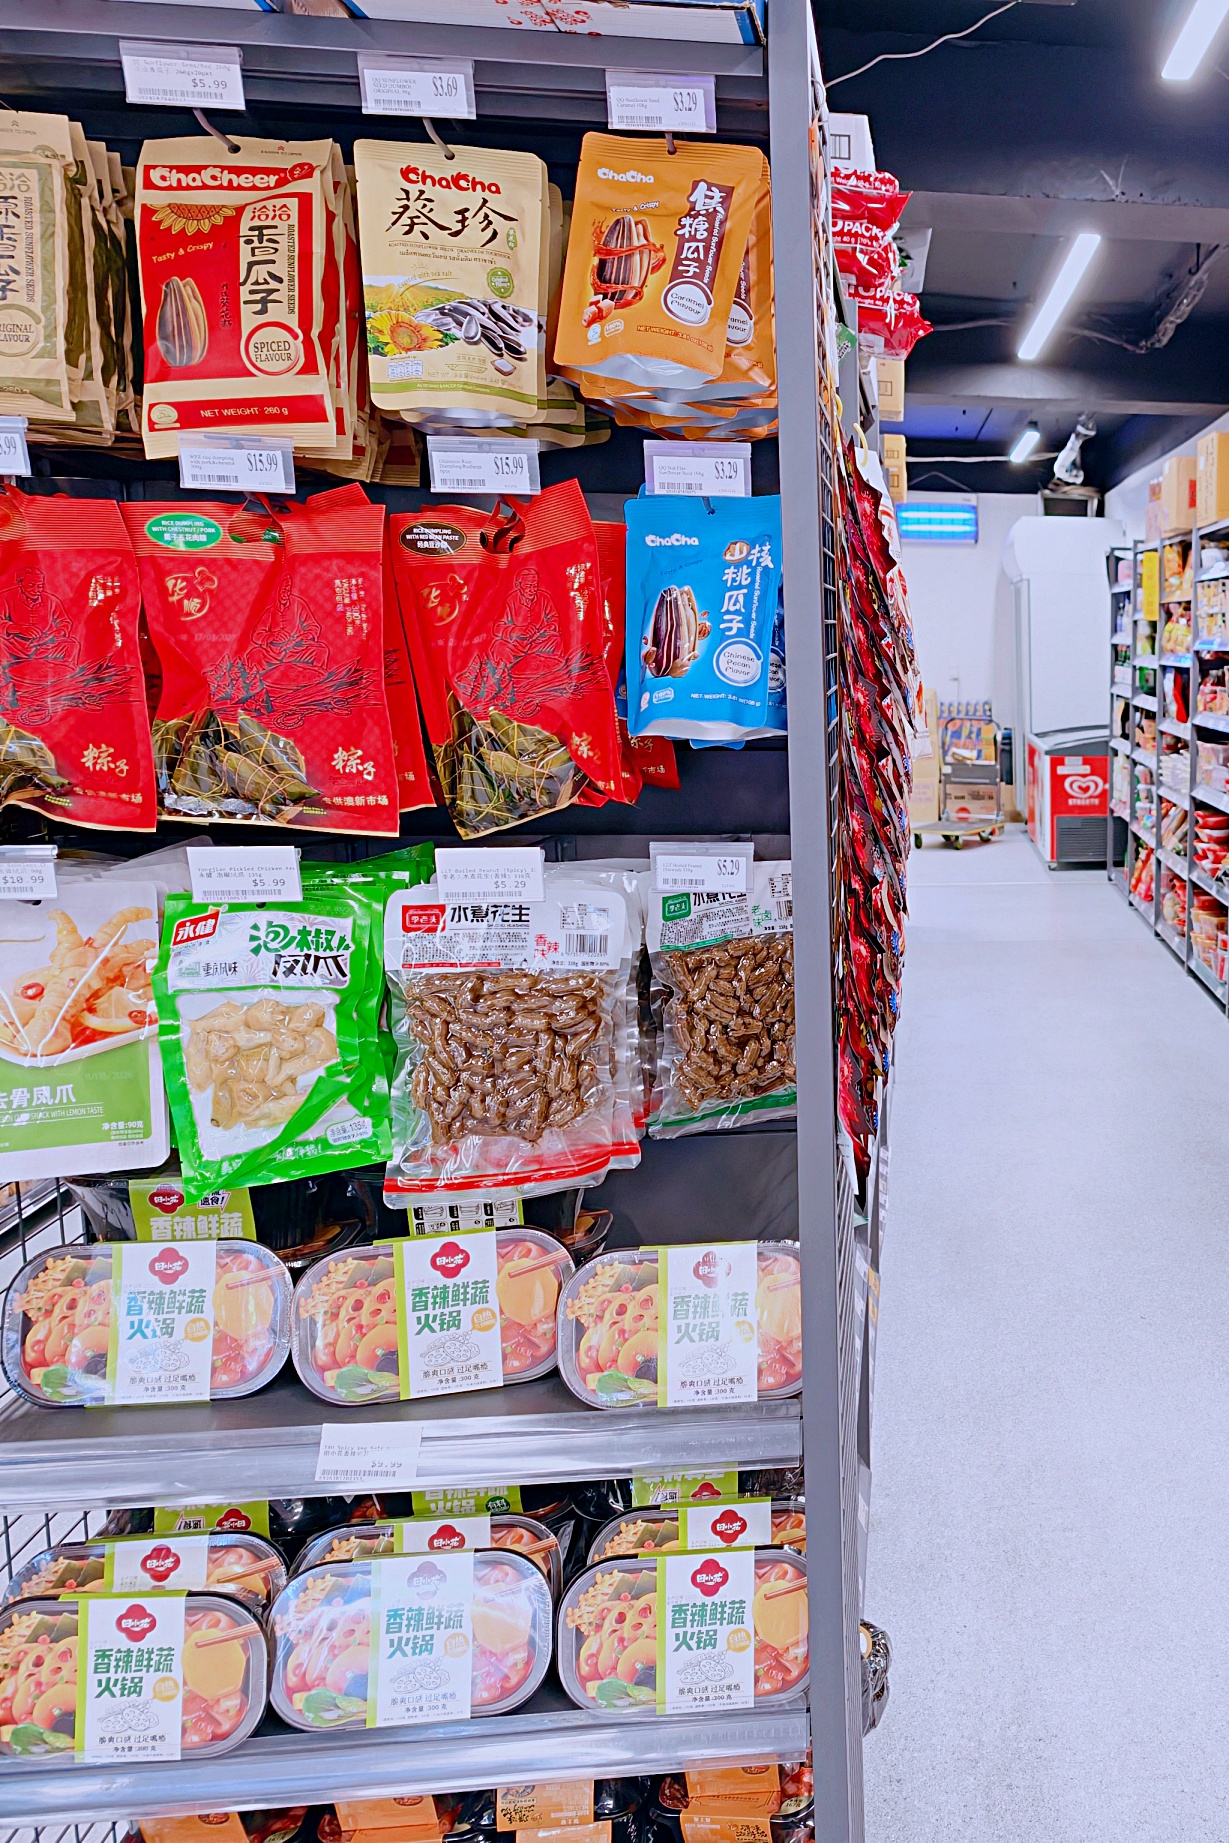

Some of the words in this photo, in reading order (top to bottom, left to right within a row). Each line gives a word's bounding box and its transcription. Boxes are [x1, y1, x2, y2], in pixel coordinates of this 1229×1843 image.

[191, 78, 227, 89] $5.99
[432, 76, 458, 97] $3.69
[673, 91, 698, 112] $3.29
[150, 167, 279, 187] ChaCheer
[400, 165, 501, 194] ChaCha
[597, 168, 655, 183] ChaCha
[250, 204, 292, 222] 洽洽
[640, 201, 660, 210] Crispy
[385, 187, 518, 247] 葵珍
[677, 181, 726, 277] 焦糖瓜子
[152, 252, 175, 263] Tasty
[178, 248, 185, 256] &
[187, 241, 214, 253] Crispy
[236, 224, 286, 317] 香瓜子
[670, 293, 705, 308] Caramel
[670, 300, 701, 316] Flavour
[253, 341, 291, 353] SPICED
[254, 352, 293, 363] FLAVOUR
[200, 409, 221, 418] NET
[263, 407, 280, 415] 260
[281, 408, 289, 416] g
[247, 452, 278, 473] $15.99
[494, 456, 524, 475] $15.99
[714, 461, 738, 479] $3.29
[168, 526, 197, 534] CHESTNUT
[645, 533, 699, 547] ChaCha
[723, 651, 755, 664] Chinese
[726, 659, 751, 670] Pecan
[724, 666, 751, 677] Flavor
[80, 743, 129, 777] 粽子
[330, 746, 376, 781] 粽子
[717, 859, 740, 876] $5.29
[252, 879, 286, 887] $5.99
[493, 880, 526, 889] $5.29
[450, 904, 531, 924] 水煮花生
[176, 918, 216, 941] 永健
[249, 920, 342, 957] 泡椒
[201, 961, 238, 977] 重庆风味
[271, 953, 349, 979] 凤爪
[51, 1109, 65, 1117] WITH
[66, 1108, 85, 1116] LEMON
[86, 1106, 104, 1115] TASTE
[102, 1121, 144, 1131] 净含量:90克
[149, 1215, 244, 1241] 香辣鲜蔬
[126, 1288, 207, 1317] 香辣鲜蔬
[411, 1280, 490, 1312] 香辣鲜蔬
[126, 1317, 175, 1341] 火锅
[415, 1312, 462, 1335] 火锅
[371, 1460, 402, 1468] $9.99
[717, 1521, 743, 1533] 田小花
[385, 1604, 464, 1632] 香辣鲜蔬
[671, 1600, 747, 1630] 香辣鲜蔬
[387, 1634, 433, 1659] 火锅
[672, 1630, 717, 1651] 火锅
[93, 1647, 175, 1675] 香辣鲜蔬
[94, 1677, 143, 1699] 火锅
